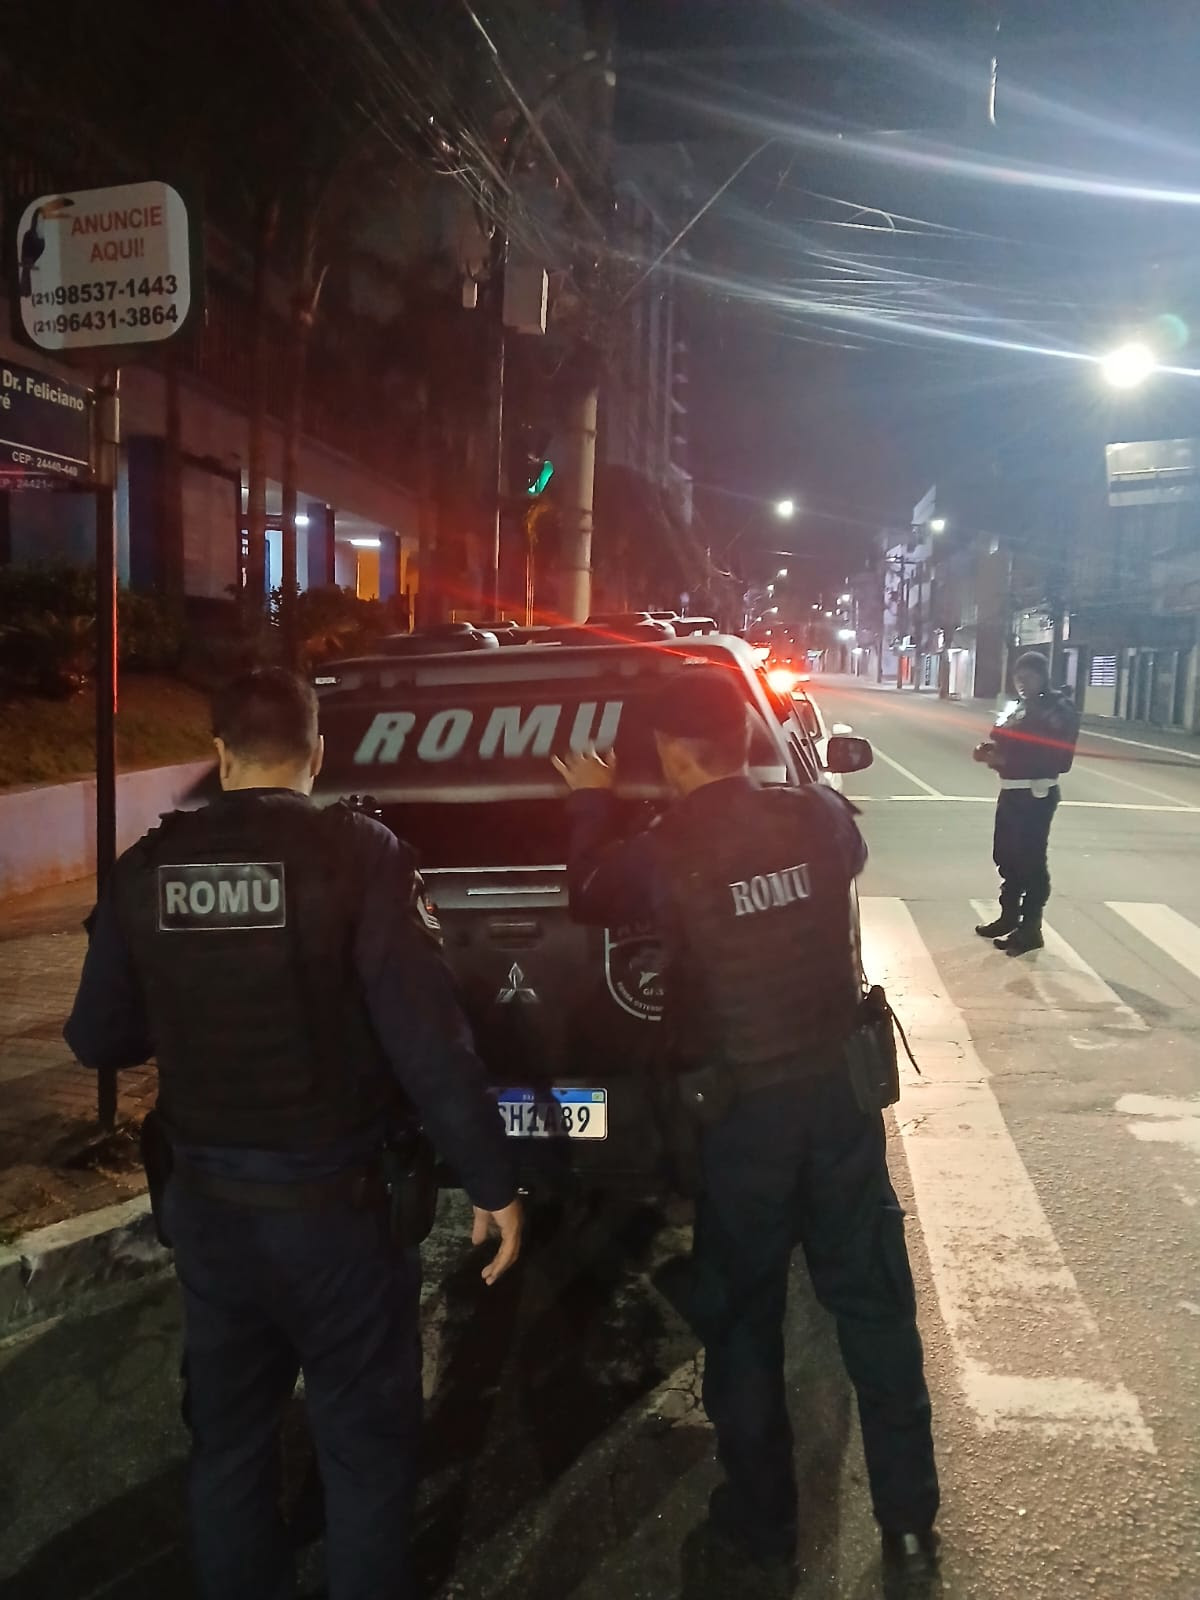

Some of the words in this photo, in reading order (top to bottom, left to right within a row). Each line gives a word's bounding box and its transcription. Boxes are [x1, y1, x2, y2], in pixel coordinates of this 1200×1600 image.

[71, 206, 162, 236] ANUNCIE
[90, 238, 144, 263] AQUI!
[3, 370, 22, 391] Dr.
[26, 377, 84, 411] Feliciano
[354, 701, 623, 763] ROMU
[166, 879, 279, 914] ROMU
[728, 863, 811, 916] ROMU
